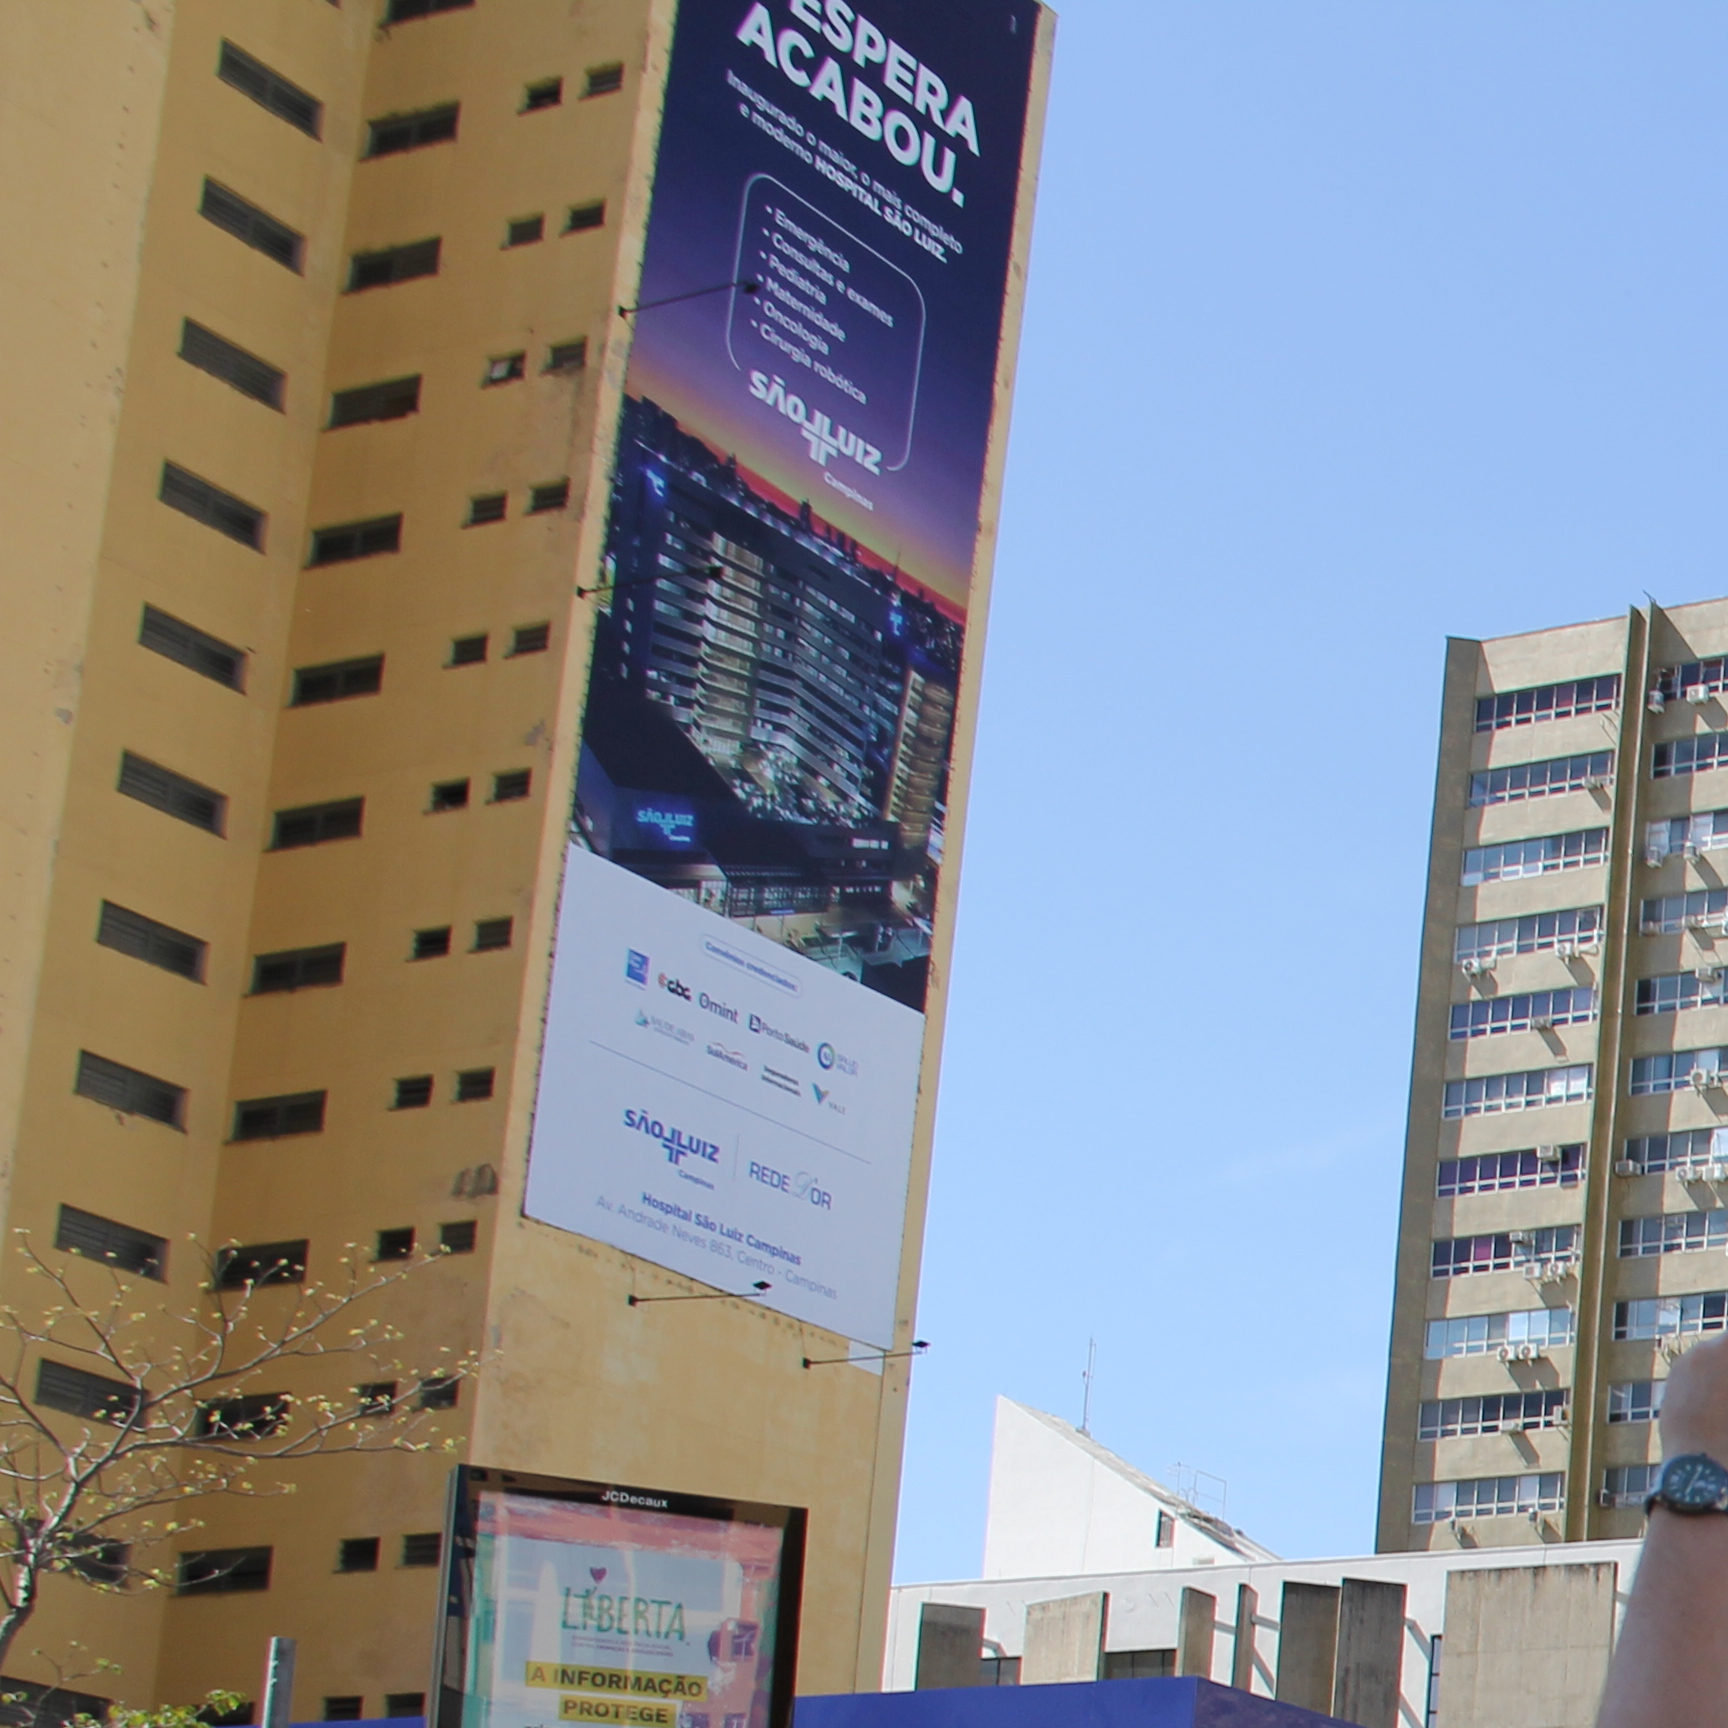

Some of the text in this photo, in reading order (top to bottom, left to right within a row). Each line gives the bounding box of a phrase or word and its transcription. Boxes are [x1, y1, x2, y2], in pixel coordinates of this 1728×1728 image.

[736, 2, 964, 208] ACABOU.
[790, 0, 980, 157] ESPERA
[726, 68, 963, 255] Inaugurado o maior, o mais completo
[739, 103, 750, 119] e
[751, 110, 814, 165] moderno
[815, 154, 884, 217] HOSPITAL
[883, 204, 914, 237] SÃO
[774, 207, 850, 274] Emergência
[765, 276, 846, 343] Maternidade
[768, 253, 827, 306] Pediatria
[771, 232, 894, 328] Consultas e exames
[763, 299, 830, 356] Oncologia
[759, 322, 868, 405] Cirurgia robótica
[824, 471, 874, 512] Campinas
[699, 991, 740, 1025] Omint
[677, 1169, 716, 1191] Campinas
[749, 1160, 791, 1193] REDE
[597, 1195, 614, 1212] Av.
[617, 1202, 669, 1234] Andrade
[672, 1224, 707, 1250] Neves
[737, 1247, 776, 1276] Centro
[785, 1268, 838, 1300] Campinas
[642, 1191, 803, 1267] Hospital São Luiz Campinas
[602, 1490, 669, 1509] JCDecaux
[529, 1666, 703, 1699] A INFORMAÇÃO
[563, 1699, 669, 1724] PROTEGE
